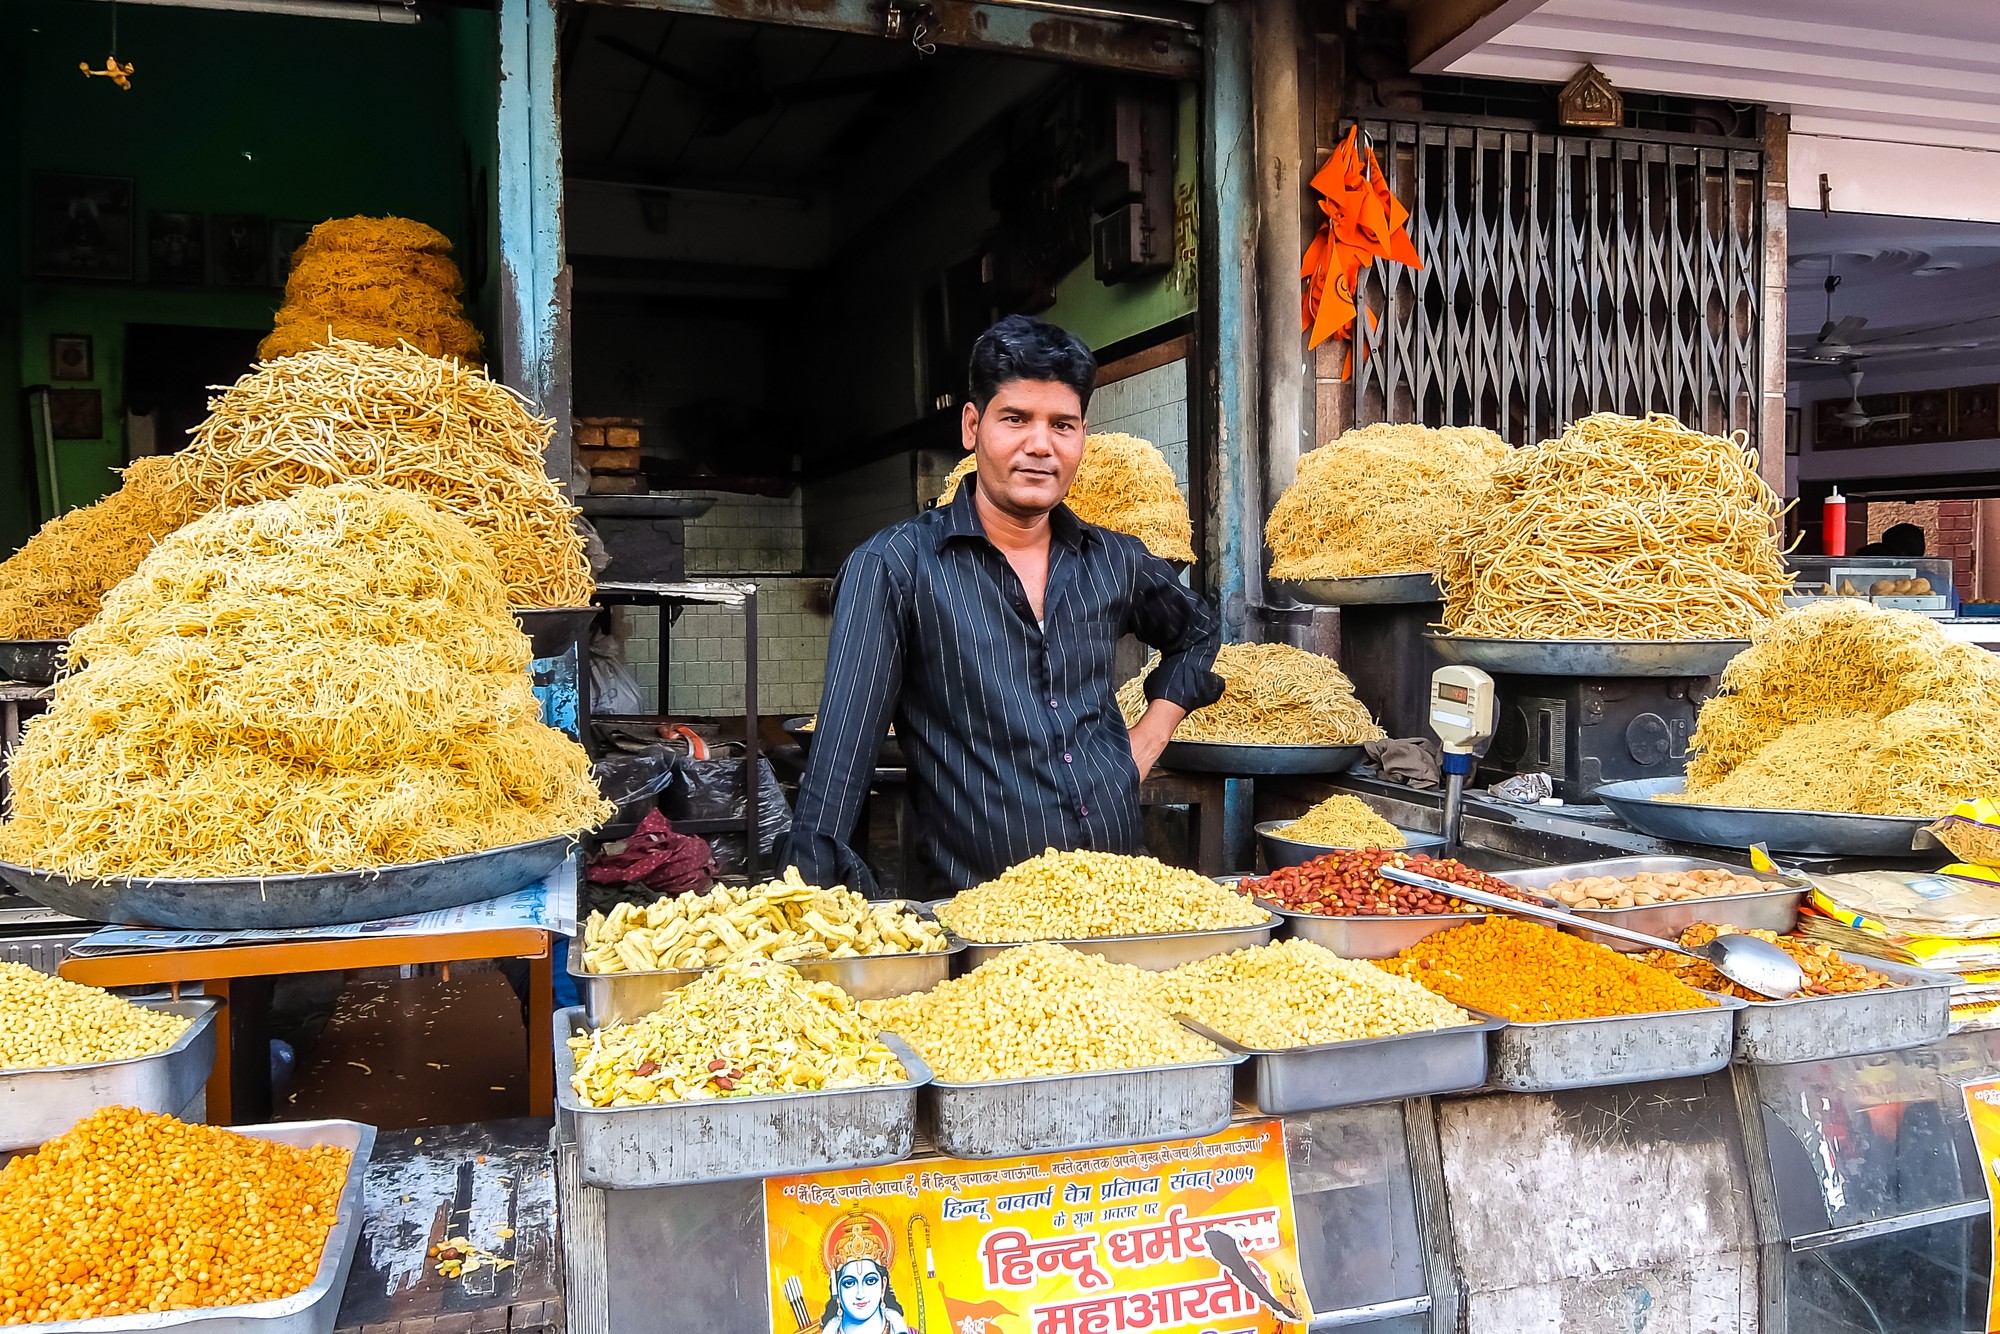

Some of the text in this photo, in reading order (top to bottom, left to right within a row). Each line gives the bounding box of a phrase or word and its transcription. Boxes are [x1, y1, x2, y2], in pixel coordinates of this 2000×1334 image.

[811, 1185, 839, 1205] हिन्दू
[838, 1180, 872, 1197] जगाने
[875, 1181, 903, 1195] आया
[921, 1173, 931, 1189] मैं
[933, 1173, 960, 1191] हिन्दू
[959, 1171, 999, 1185] जगाकर
[1052, 1158, 1074, 1174] मरते
[1076, 1160, 1090, 1173] दम
[1093, 1158, 1110, 1170] तक
[1113, 1151, 1137, 1167] अपने
[1139, 1152, 1160, 1169] मुख
[1161, 1146, 1171, 1161] से
[1172, 1148, 1190, 1160] जय
[1192, 1142, 1204, 1157] श्री
[1207, 1144, 1222, 1156] राम
[943, 1167, 1254, 1221] हिन्दू नववर्ष चैत्र प्रतिपदा संवत् २०७५
[1053, 1203, 1159, 1227] के शुभ अवसर पर
[984, 1231, 1107, 1286] हिन्दू
